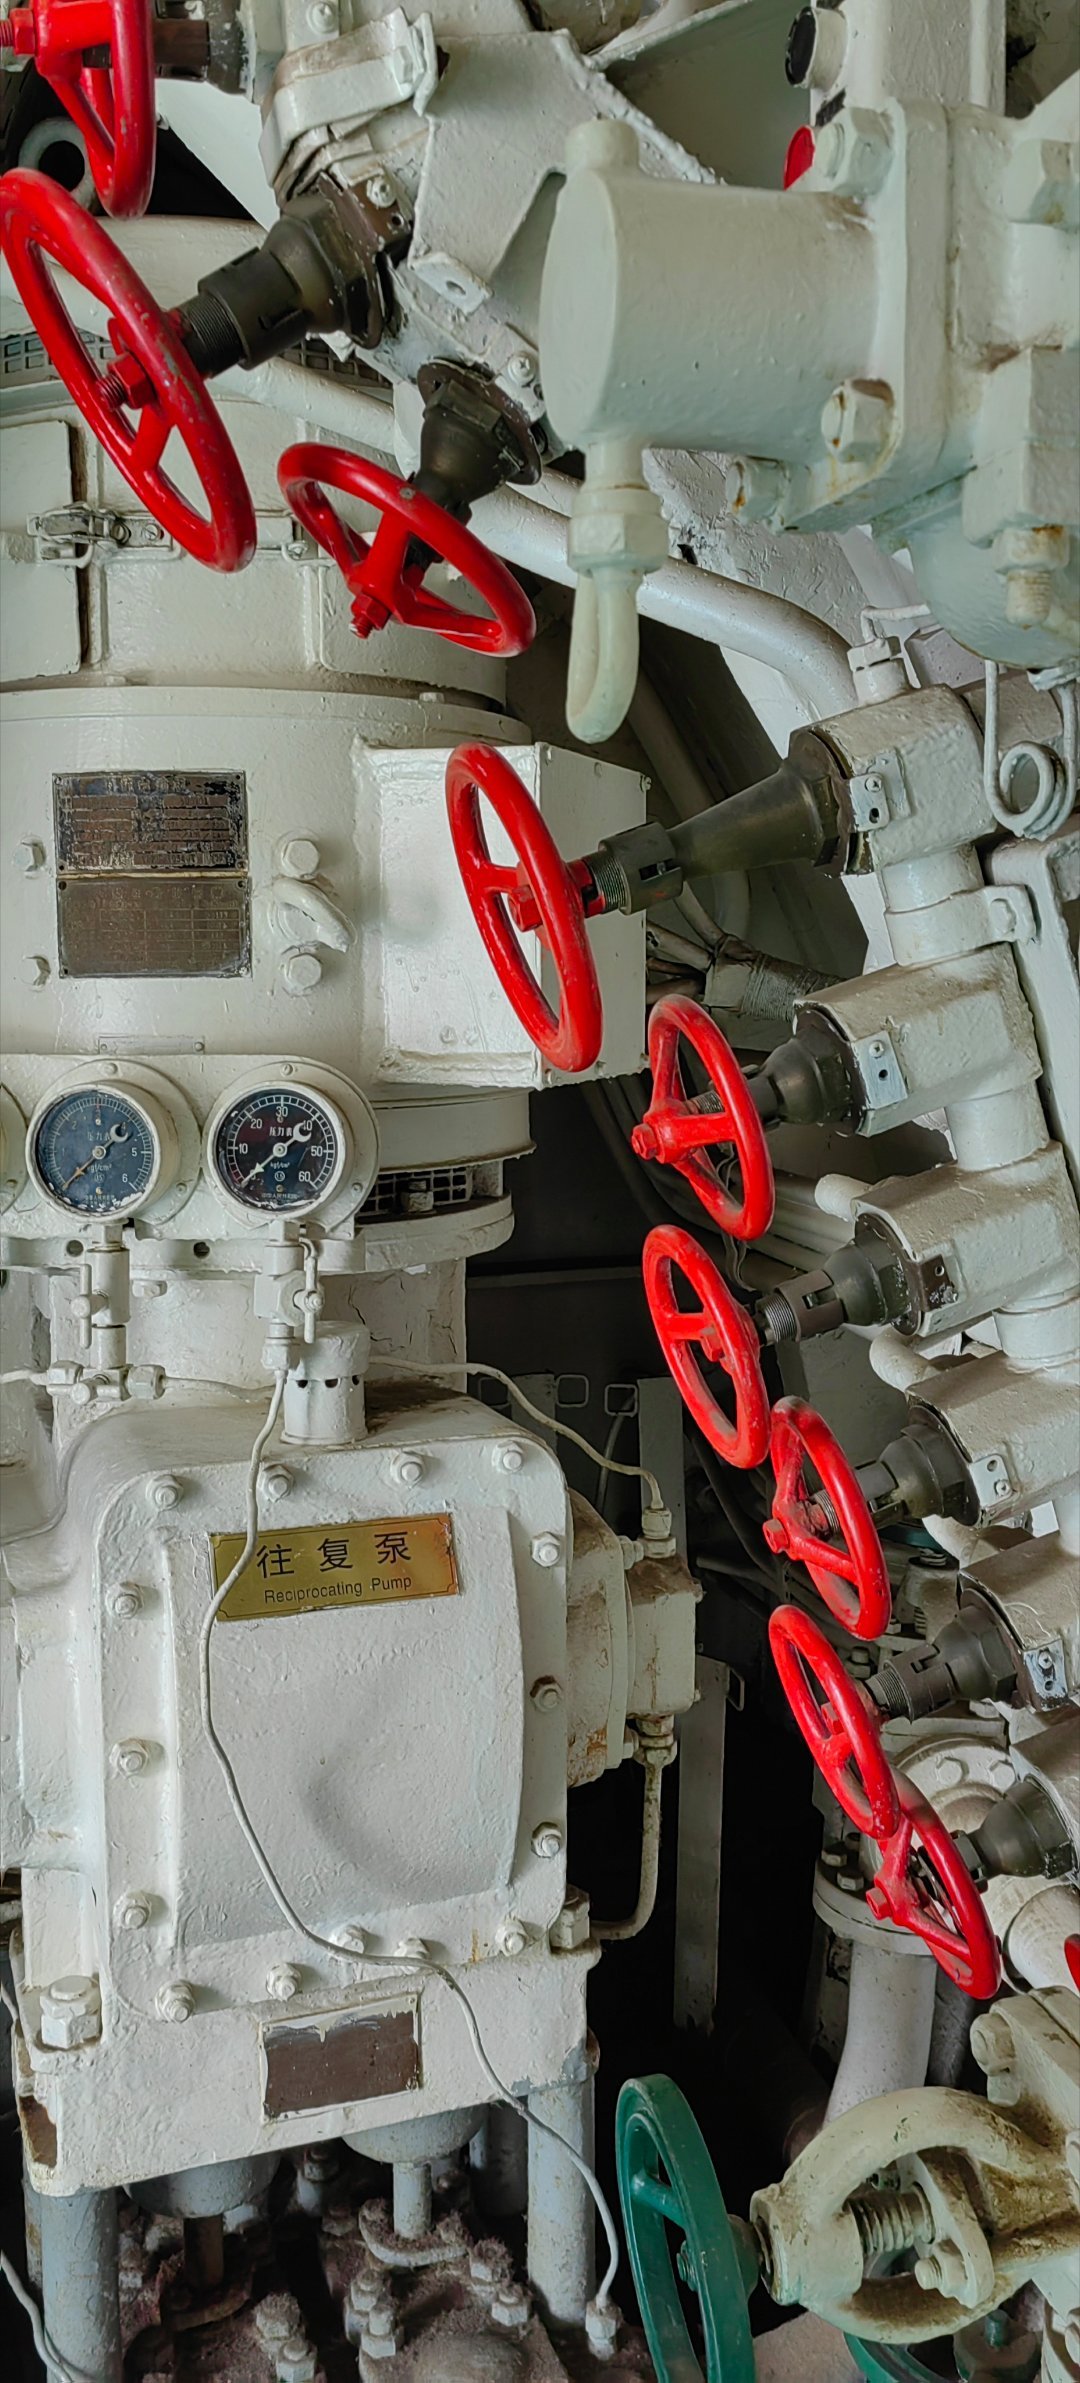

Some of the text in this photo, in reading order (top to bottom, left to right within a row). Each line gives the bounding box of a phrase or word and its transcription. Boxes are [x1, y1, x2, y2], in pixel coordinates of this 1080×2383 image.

[275, 1106, 289, 1117] 30
[250, 1118, 263, 1129] 20
[131, 1147, 138, 1157] 5
[239, 1143, 248, 1154] 10
[311, 1146, 323, 1157] 50
[122, 1173, 128, 1183] 6
[298, 1171, 311, 1182] 60
[256, 1531, 412, 1579] 往复泵
[264, 1575, 412, 1604] Reciprocating Pump
